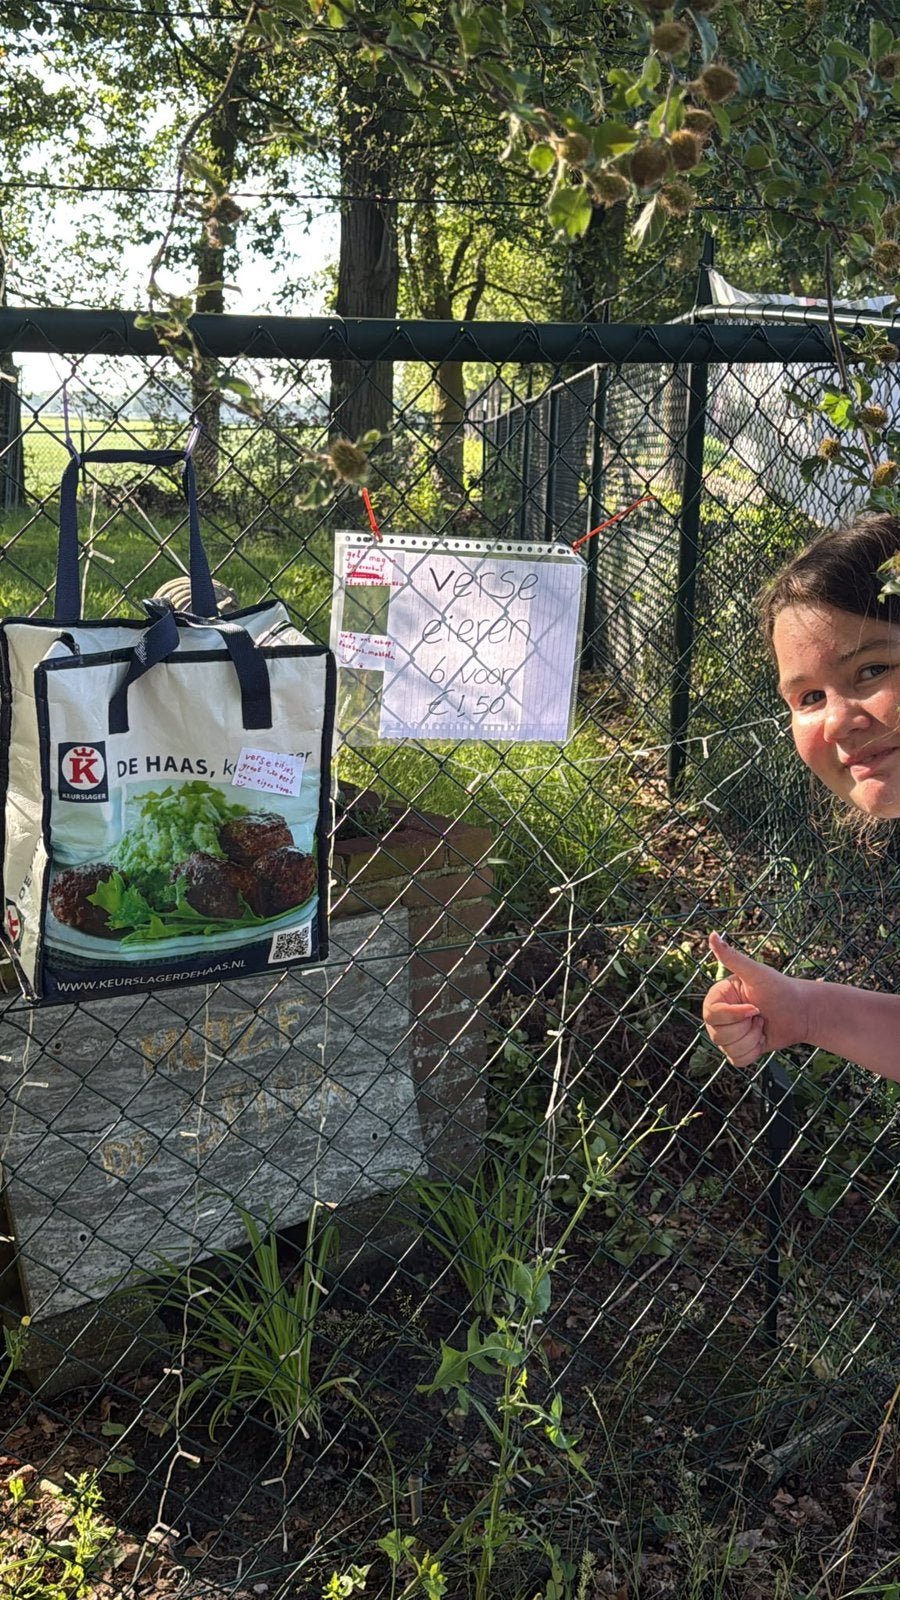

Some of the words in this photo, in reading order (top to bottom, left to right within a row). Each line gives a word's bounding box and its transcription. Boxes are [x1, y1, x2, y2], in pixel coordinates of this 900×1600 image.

[421, 614, 532, 646] eieren
[428, 655, 446, 684] 6
[460, 665, 516, 687] voor
[117, 756, 138, 778] DE
[146, 755, 215, 778] HAAS,
[245, 753, 273, 768] verse
[238, 774, 253, 782] van
[61, 793, 107, 801] KEURSLAGER
[56, 958, 248, 993] WWW.KEURSLAGERDEHAAS.NL
